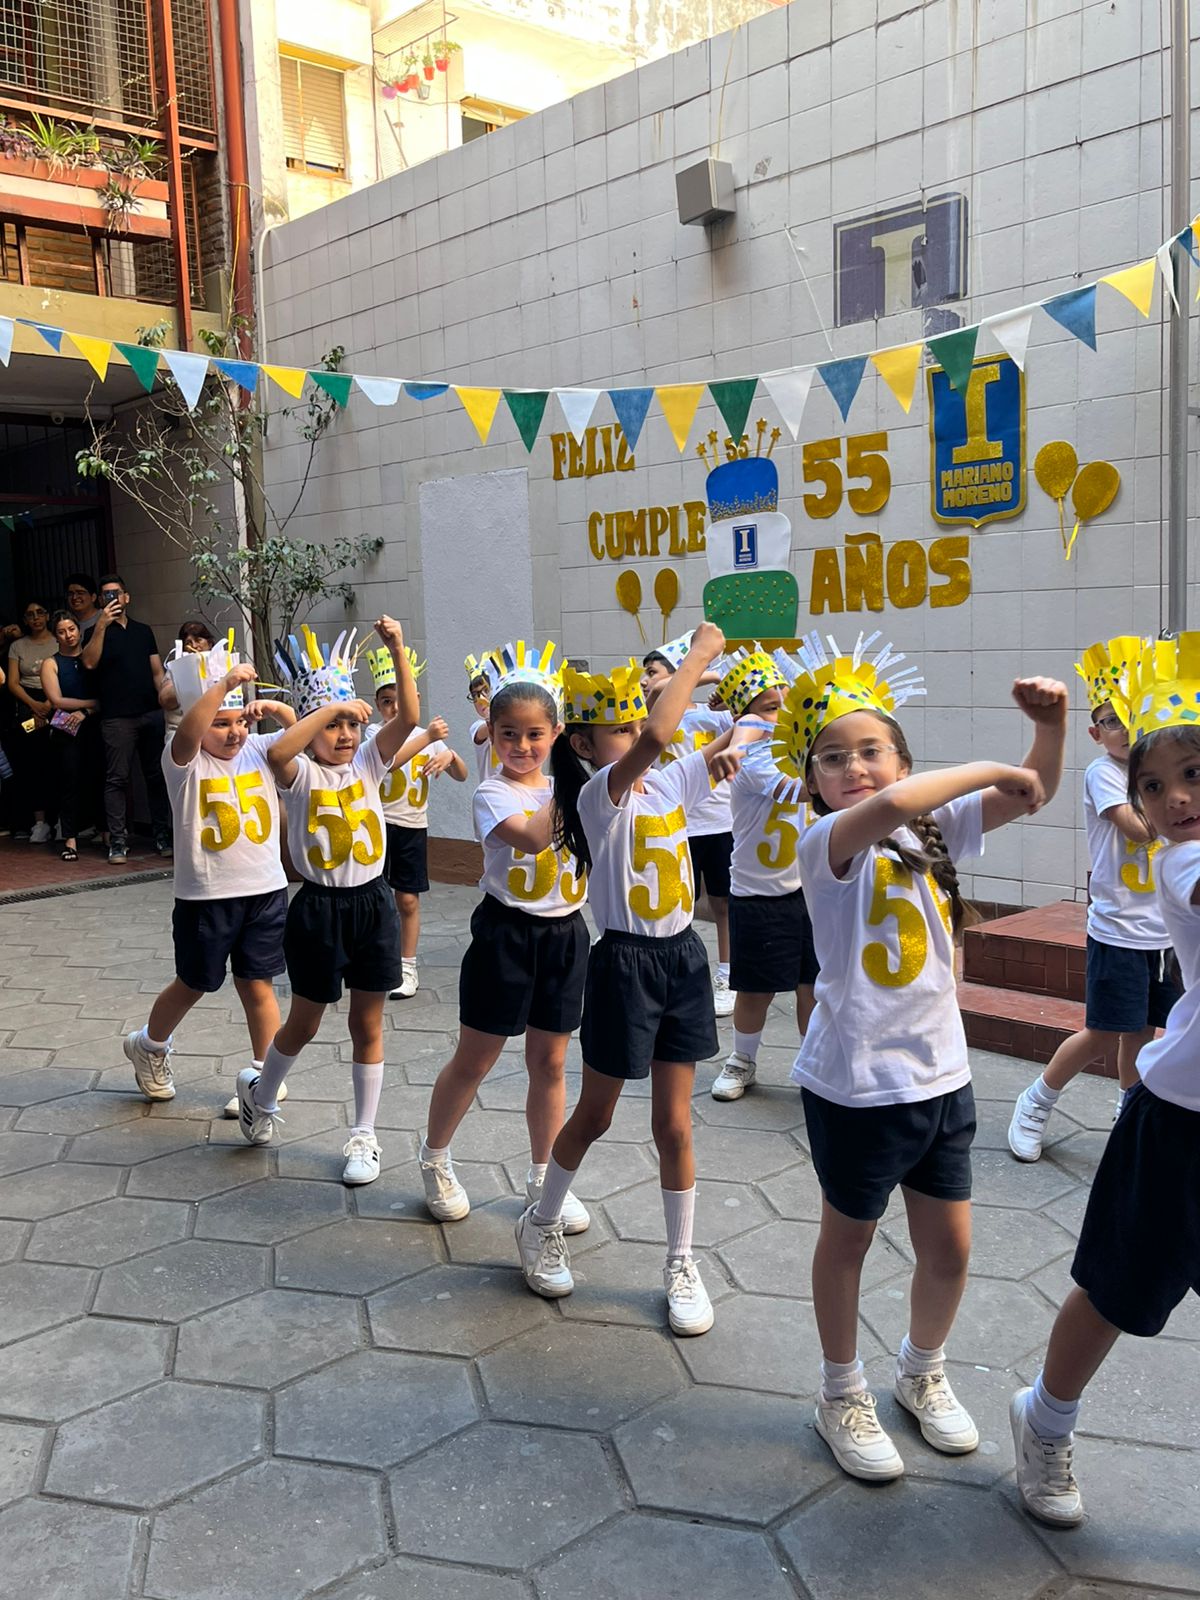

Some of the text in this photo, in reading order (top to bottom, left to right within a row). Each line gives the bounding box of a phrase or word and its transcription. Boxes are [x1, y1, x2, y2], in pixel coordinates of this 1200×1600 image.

[551, 423, 635, 480] FELIZ
[723, 434, 749, 462] 55
[802, 432, 891, 519] 55
[941, 461, 1014, 489] MARIANO
[942, 481, 1013, 509] MORENO
[588, 500, 706, 560] CUMPLE
[809, 532, 971, 615] AÑOS
[200, 770, 271, 851] 55
[307, 780, 384, 870] 55
